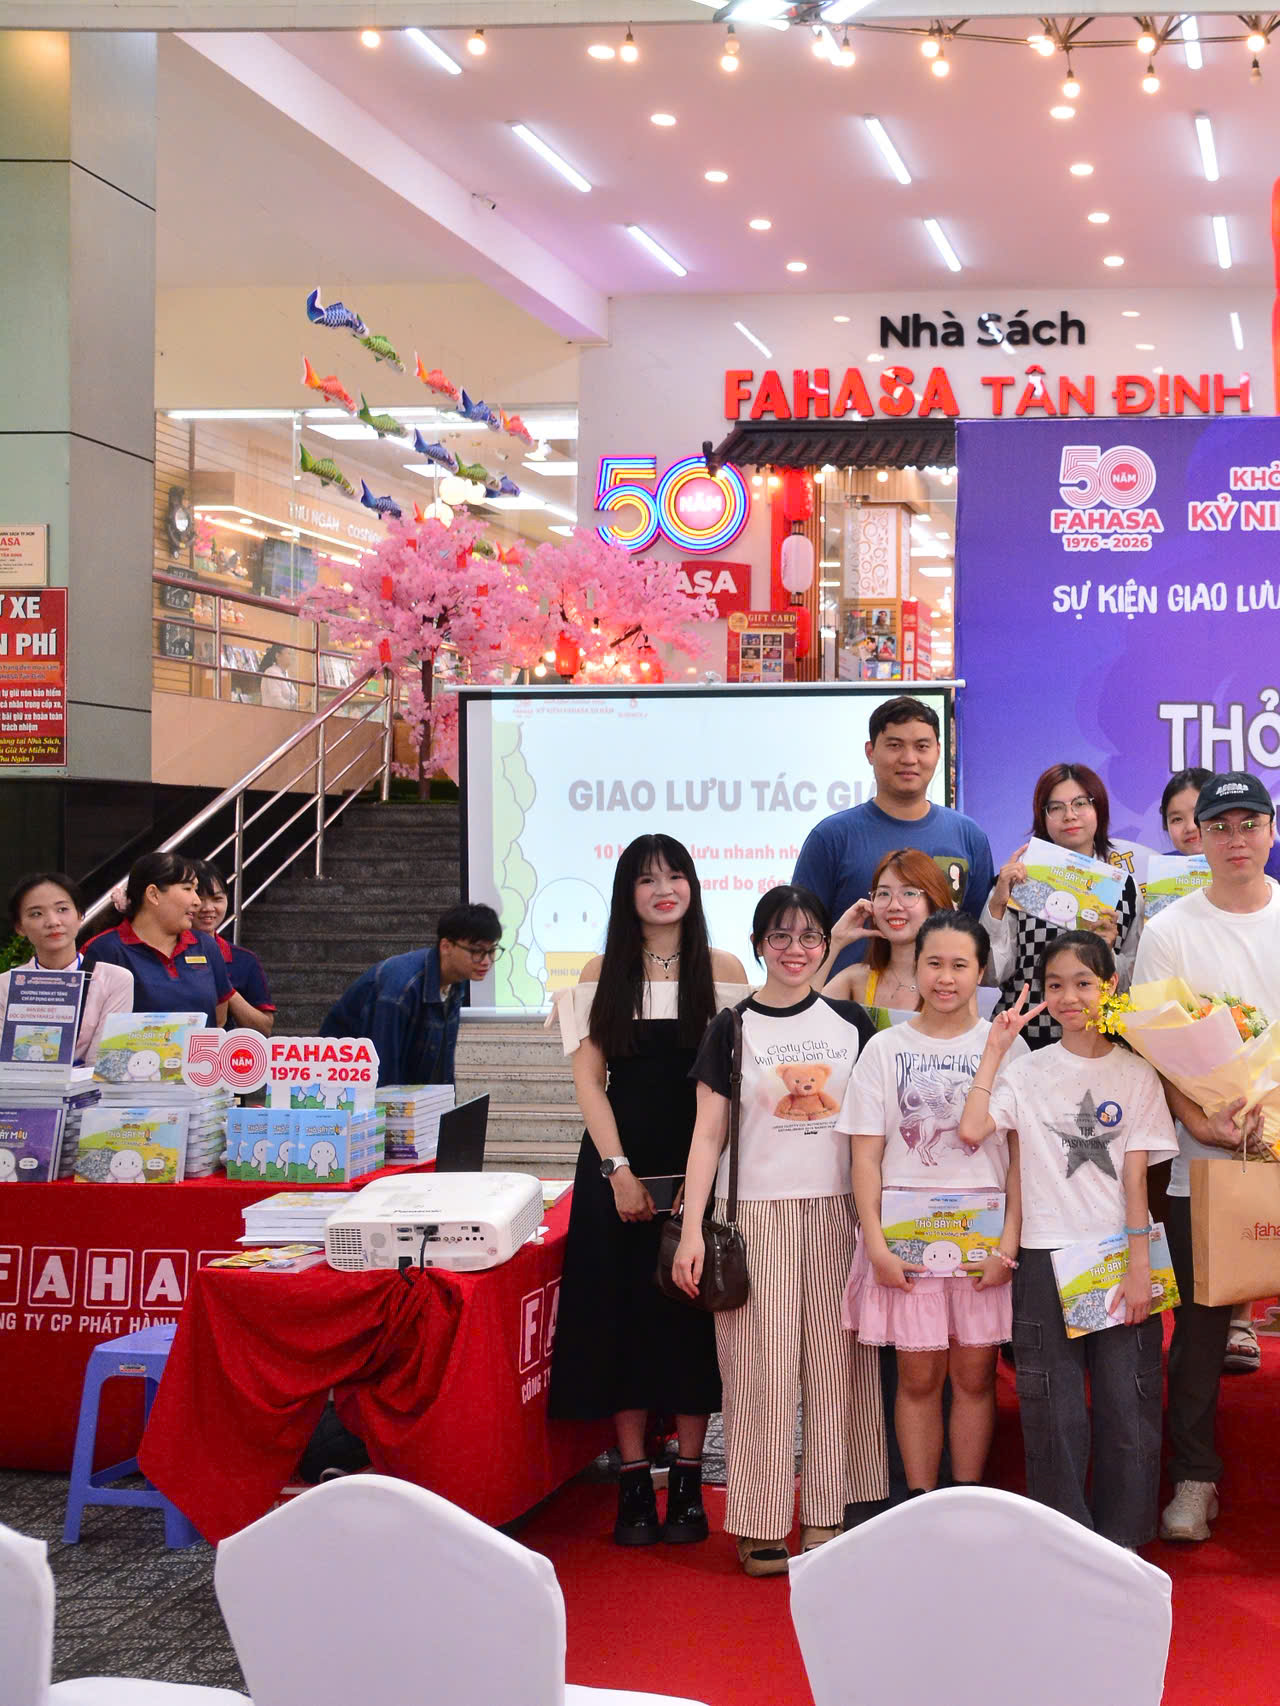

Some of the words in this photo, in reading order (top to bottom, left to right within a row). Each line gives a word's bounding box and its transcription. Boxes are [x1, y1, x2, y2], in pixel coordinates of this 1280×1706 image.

[880, 312, 964, 348] Nhà
[977, 311, 1086, 346] Sách
[725, 366, 960, 421] FAHASA
[981, 365, 1096, 416] TÂN
[1112, 471, 1137, 484] NĂM
[594, 455, 750, 555] 50
[680, 492, 722, 513] NĂM
[1191, 495, 1237, 530] KỶ
[1052, 510, 1163, 531] FAHASA
[1, 537, 21, 546] ASA
[1065, 537, 1100, 549] 1976
[1113, 537, 1149, 549] 2026
[10, 596, 41, 619] XE
[1053, 580, 1091, 619] SỰ
[1098, 579, 1157, 619] KIỆN
[1168, 583, 1226, 611] GIAO
[748, 614, 768, 622] GIFT
[771, 614, 796, 622] CARD
[16, 628, 57, 656] PHÍ
[568, 779, 656, 812] GIAO
[666, 778, 742, 812] LƯU
[751, 772, 818, 812] TÁC
[826, 780, 877, 812] GI
[594, 844, 613, 860] 10
[723, 844, 776, 860] nhanh
[701, 876, 729, 890] ard
[733, 875, 754, 891] bo
[187, 1035, 268, 1088] 50
[231, 1057, 254, 1067] NĂM
[271, 1044, 372, 1063] FAHASA
[271, 1067, 311, 1081] 1976
[327, 1067, 371, 1082] 2026
[896, 1052, 983, 1090] DREAMCHAS
[915, 1219, 932, 1229] THỎ
[24, 1313, 45, 1331] TY
[51, 1313, 73, 1332] CP
[79, 1312, 123, 1334] PHÁT
